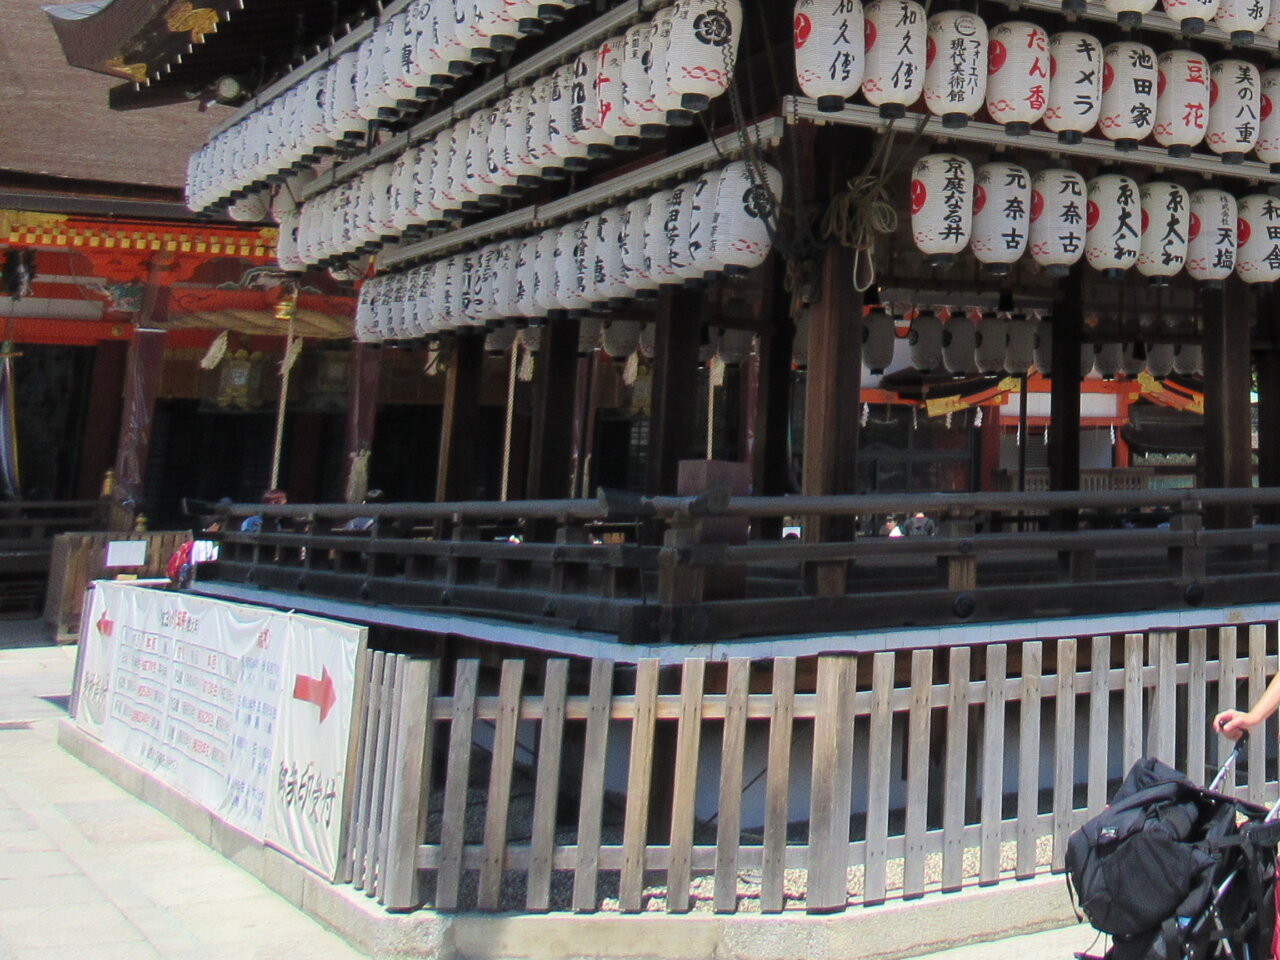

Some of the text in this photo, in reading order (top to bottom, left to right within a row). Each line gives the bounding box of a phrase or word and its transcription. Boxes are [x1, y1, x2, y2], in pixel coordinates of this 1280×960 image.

[891, 1, 918, 90] 和久傳
[946, 38, 967, 103] 現代美術館
[1024, 28, 1047, 111] だん香
[1073, 38, 1096, 116] キメラ
[1129, 49, 1153, 129] 池田家
[1182, 59, 1205, 129] 豆花
[1235, 65, 1257, 145] 美の八重
[1001, 168, 1027, 250] 元奈古
[1059, 175, 1083, 254] 元奈古
[1212, 226, 1235, 270] 天塩
